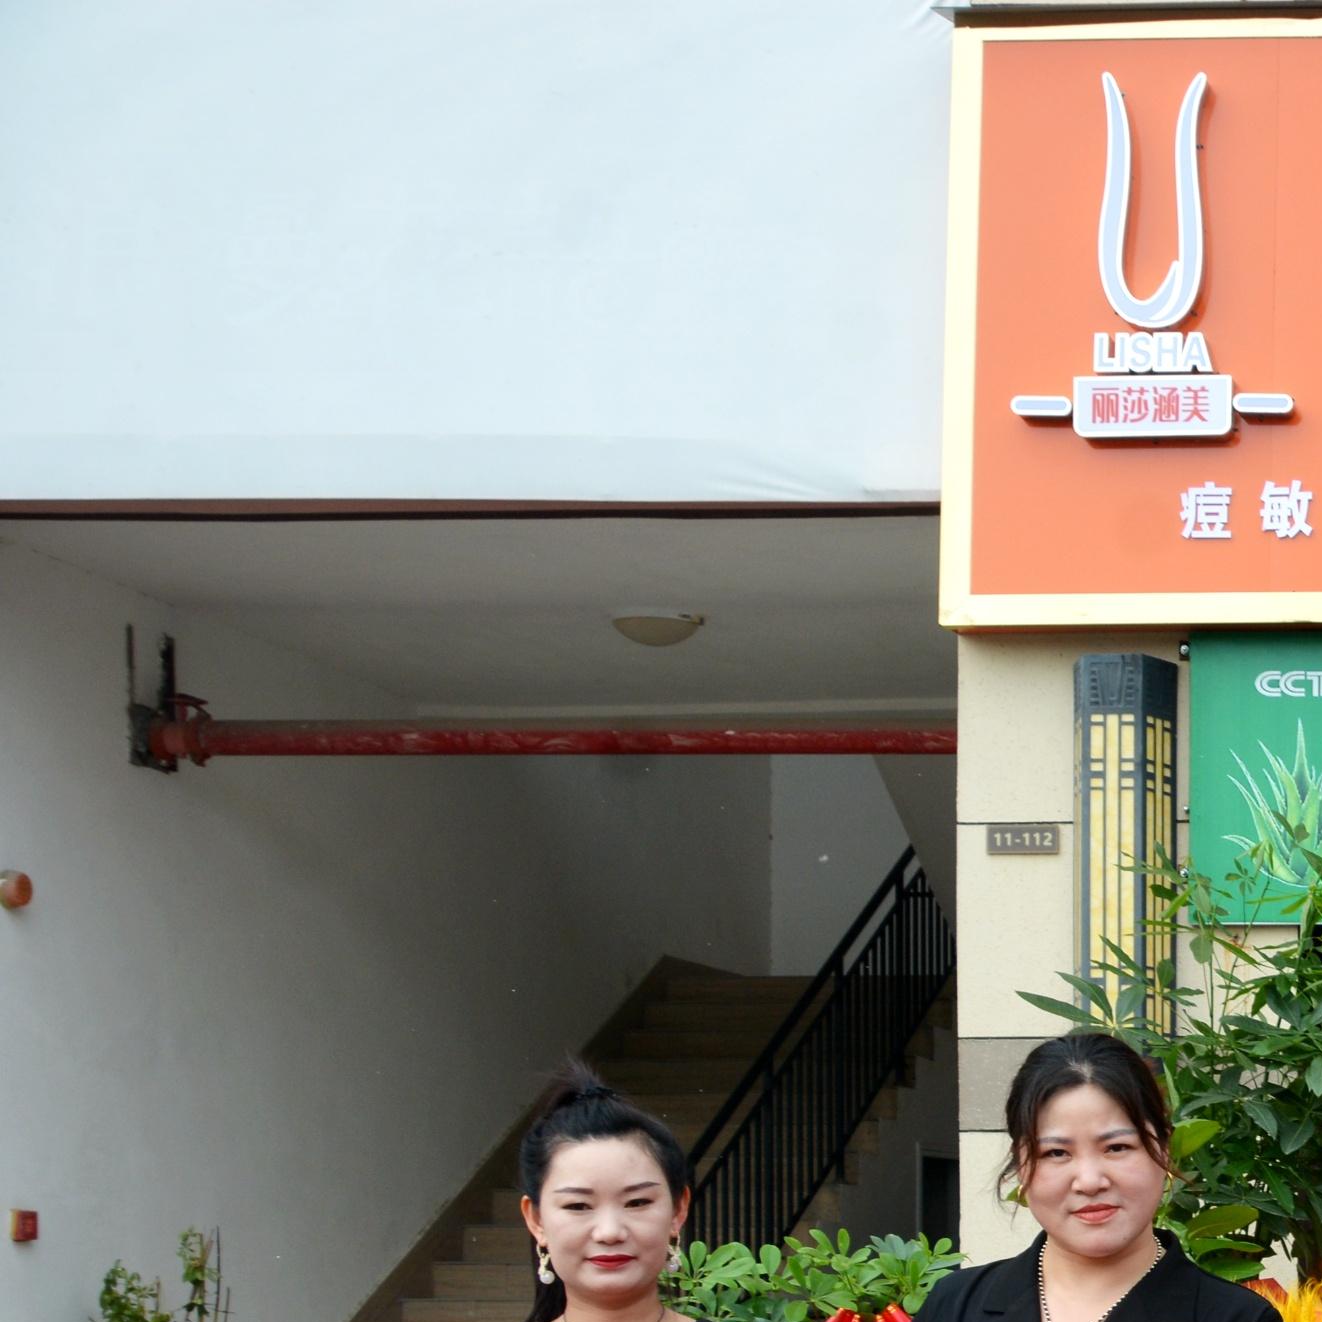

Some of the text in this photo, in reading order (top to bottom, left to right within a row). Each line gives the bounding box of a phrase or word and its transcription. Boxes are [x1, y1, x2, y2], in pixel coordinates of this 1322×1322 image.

[1093, 331, 1214, 373] LISHA
[1092, 386, 1210, 424] 丽莎涵美
[993, 832, 1053, 847] 11-112
